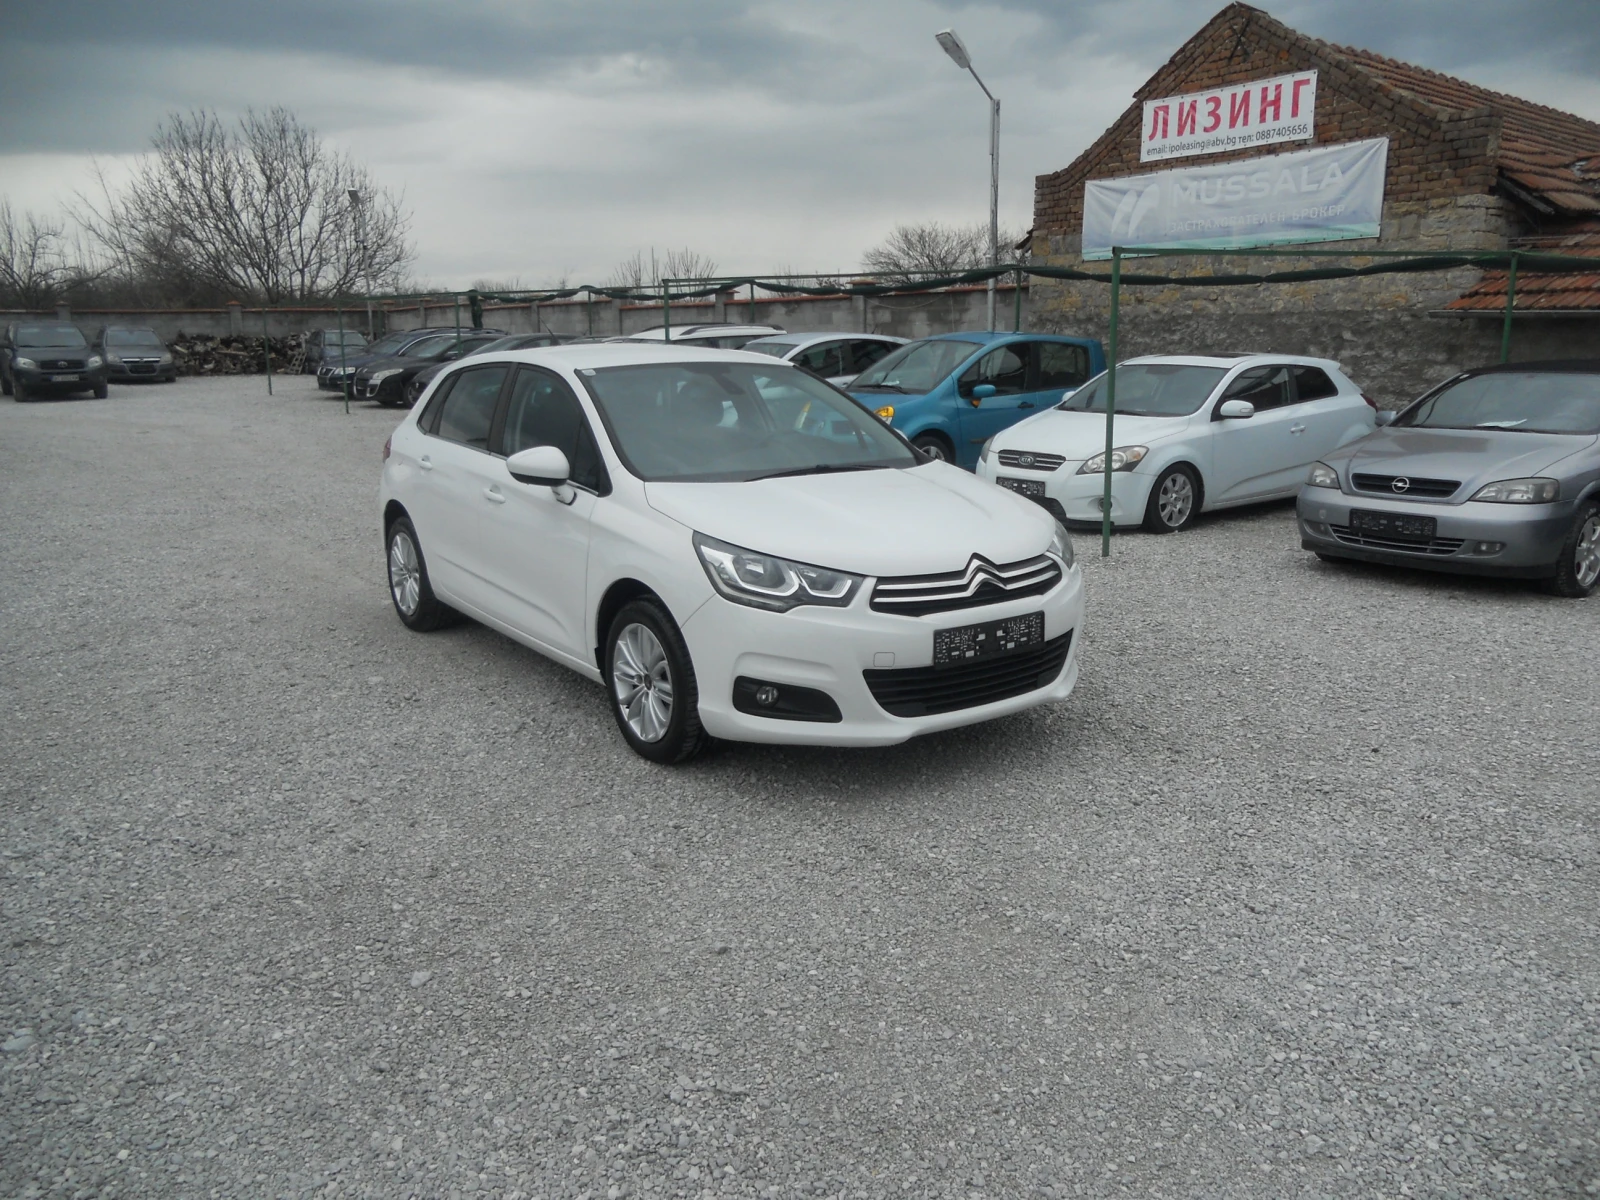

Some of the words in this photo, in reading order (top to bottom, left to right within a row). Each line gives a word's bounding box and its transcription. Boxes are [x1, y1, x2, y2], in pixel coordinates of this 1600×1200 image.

[1148, 78, 1310, 141] ЛИЗИНГ
[1147, 144, 1167, 155] email:
[1169, 135, 1236, 154] ipoleasing@abv.bg
[1255, 124, 1308, 141] 0887405656
[1173, 162, 1345, 207] MUSSALA
[1170, 211, 1286, 233] ЗАСТРАХОВАТЕЛЕН
[1292, 204, 1345, 221] БРОКЕР
